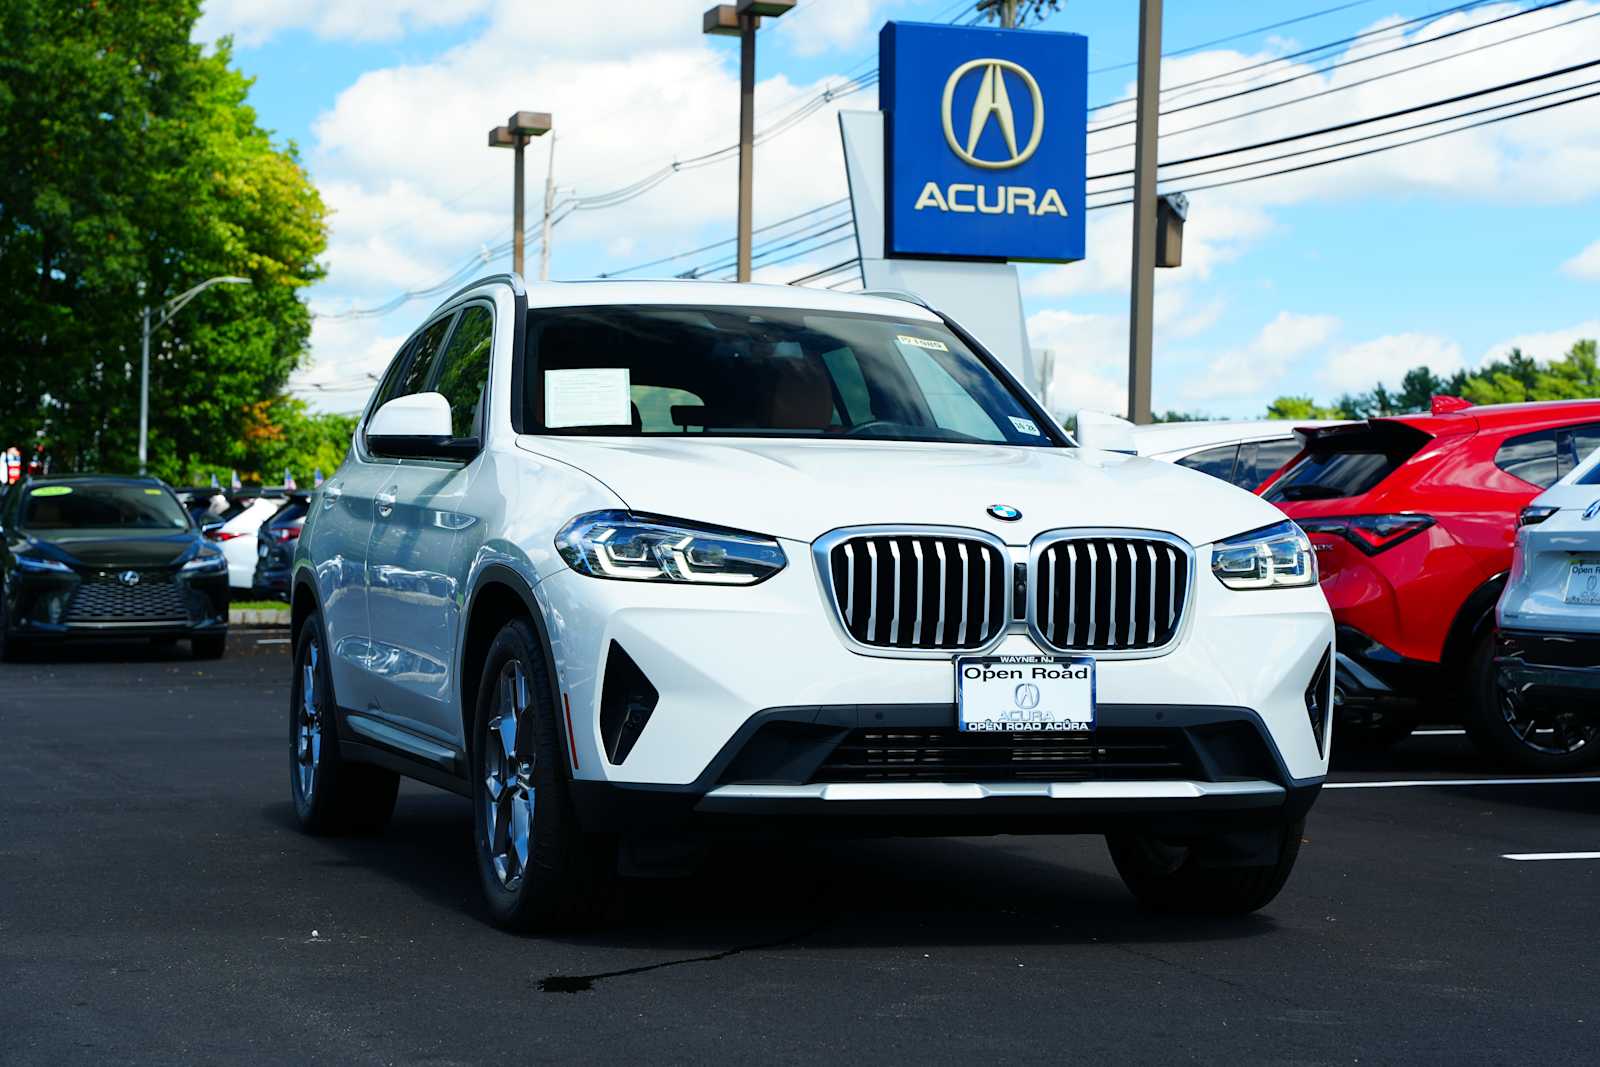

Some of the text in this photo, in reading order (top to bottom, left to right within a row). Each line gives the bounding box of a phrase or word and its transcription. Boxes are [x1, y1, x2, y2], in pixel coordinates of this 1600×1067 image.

[914, 182, 1069, 217] ACURA
[1572, 566, 1593, 576] Open
[964, 667, 1088, 682] Open Road
[998, 710, 1056, 721] ACURA
[968, 722, 1089, 731] OPEN ROAD ACURA
